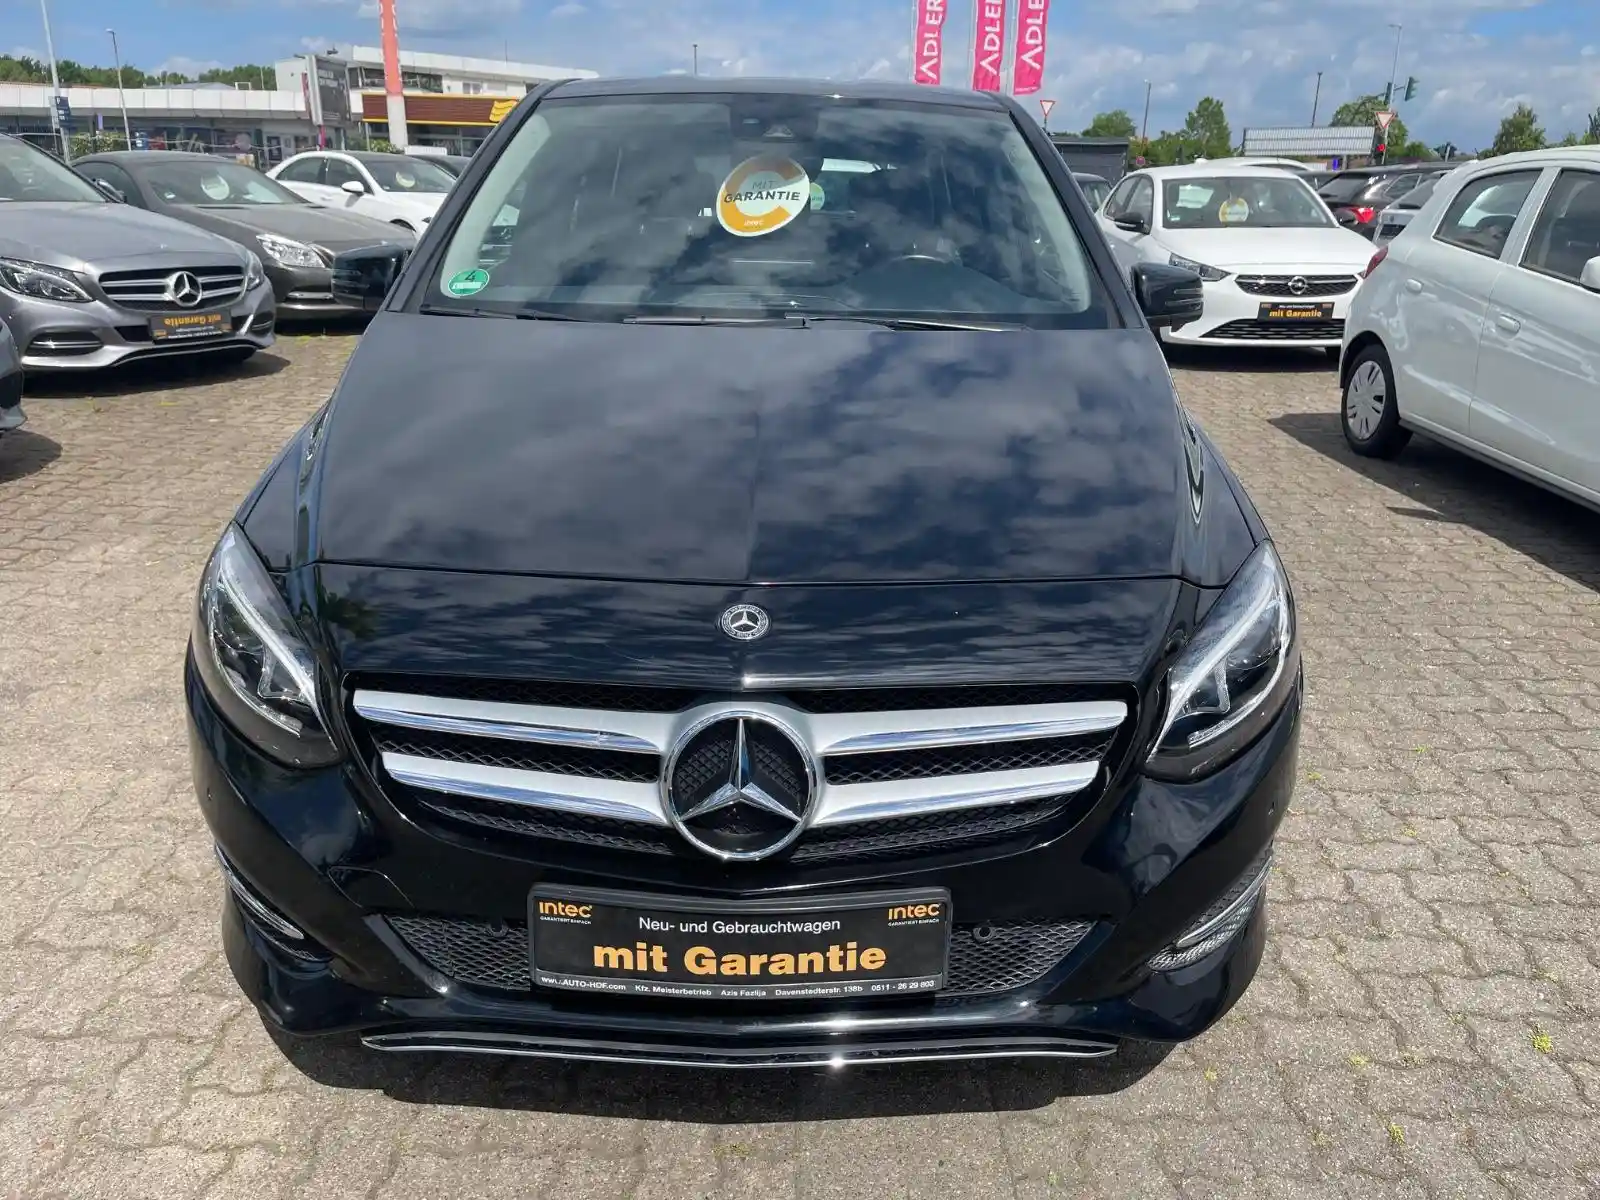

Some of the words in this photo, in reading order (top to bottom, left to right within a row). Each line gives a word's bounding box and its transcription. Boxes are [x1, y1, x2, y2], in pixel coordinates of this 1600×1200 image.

[920, 0, 943, 79] ADLER
[752, 180, 779, 190] MIT
[724, 191, 801, 203] GARANTIE
[465, 271, 476, 282] 4
[1269, 309, 1284, 317] mit
[1286, 309, 1322, 318] Garantie
[164, 315, 206, 327] Garantie
[639, 917, 675, 931] Neu-
[680, 921, 707, 933] und
[712, 920, 841, 934] Gebrauchtwagen
[593, 942, 668, 973] mit
[683, 942, 887, 976] Garantie
[635, 984, 651, 993] Kfz.
[652, 986, 712, 996] Meisterbetrieb
[843, 985, 863, 993] 138b
[871, 983, 890, 991] 0511
[898, 982, 907, 990] 26
